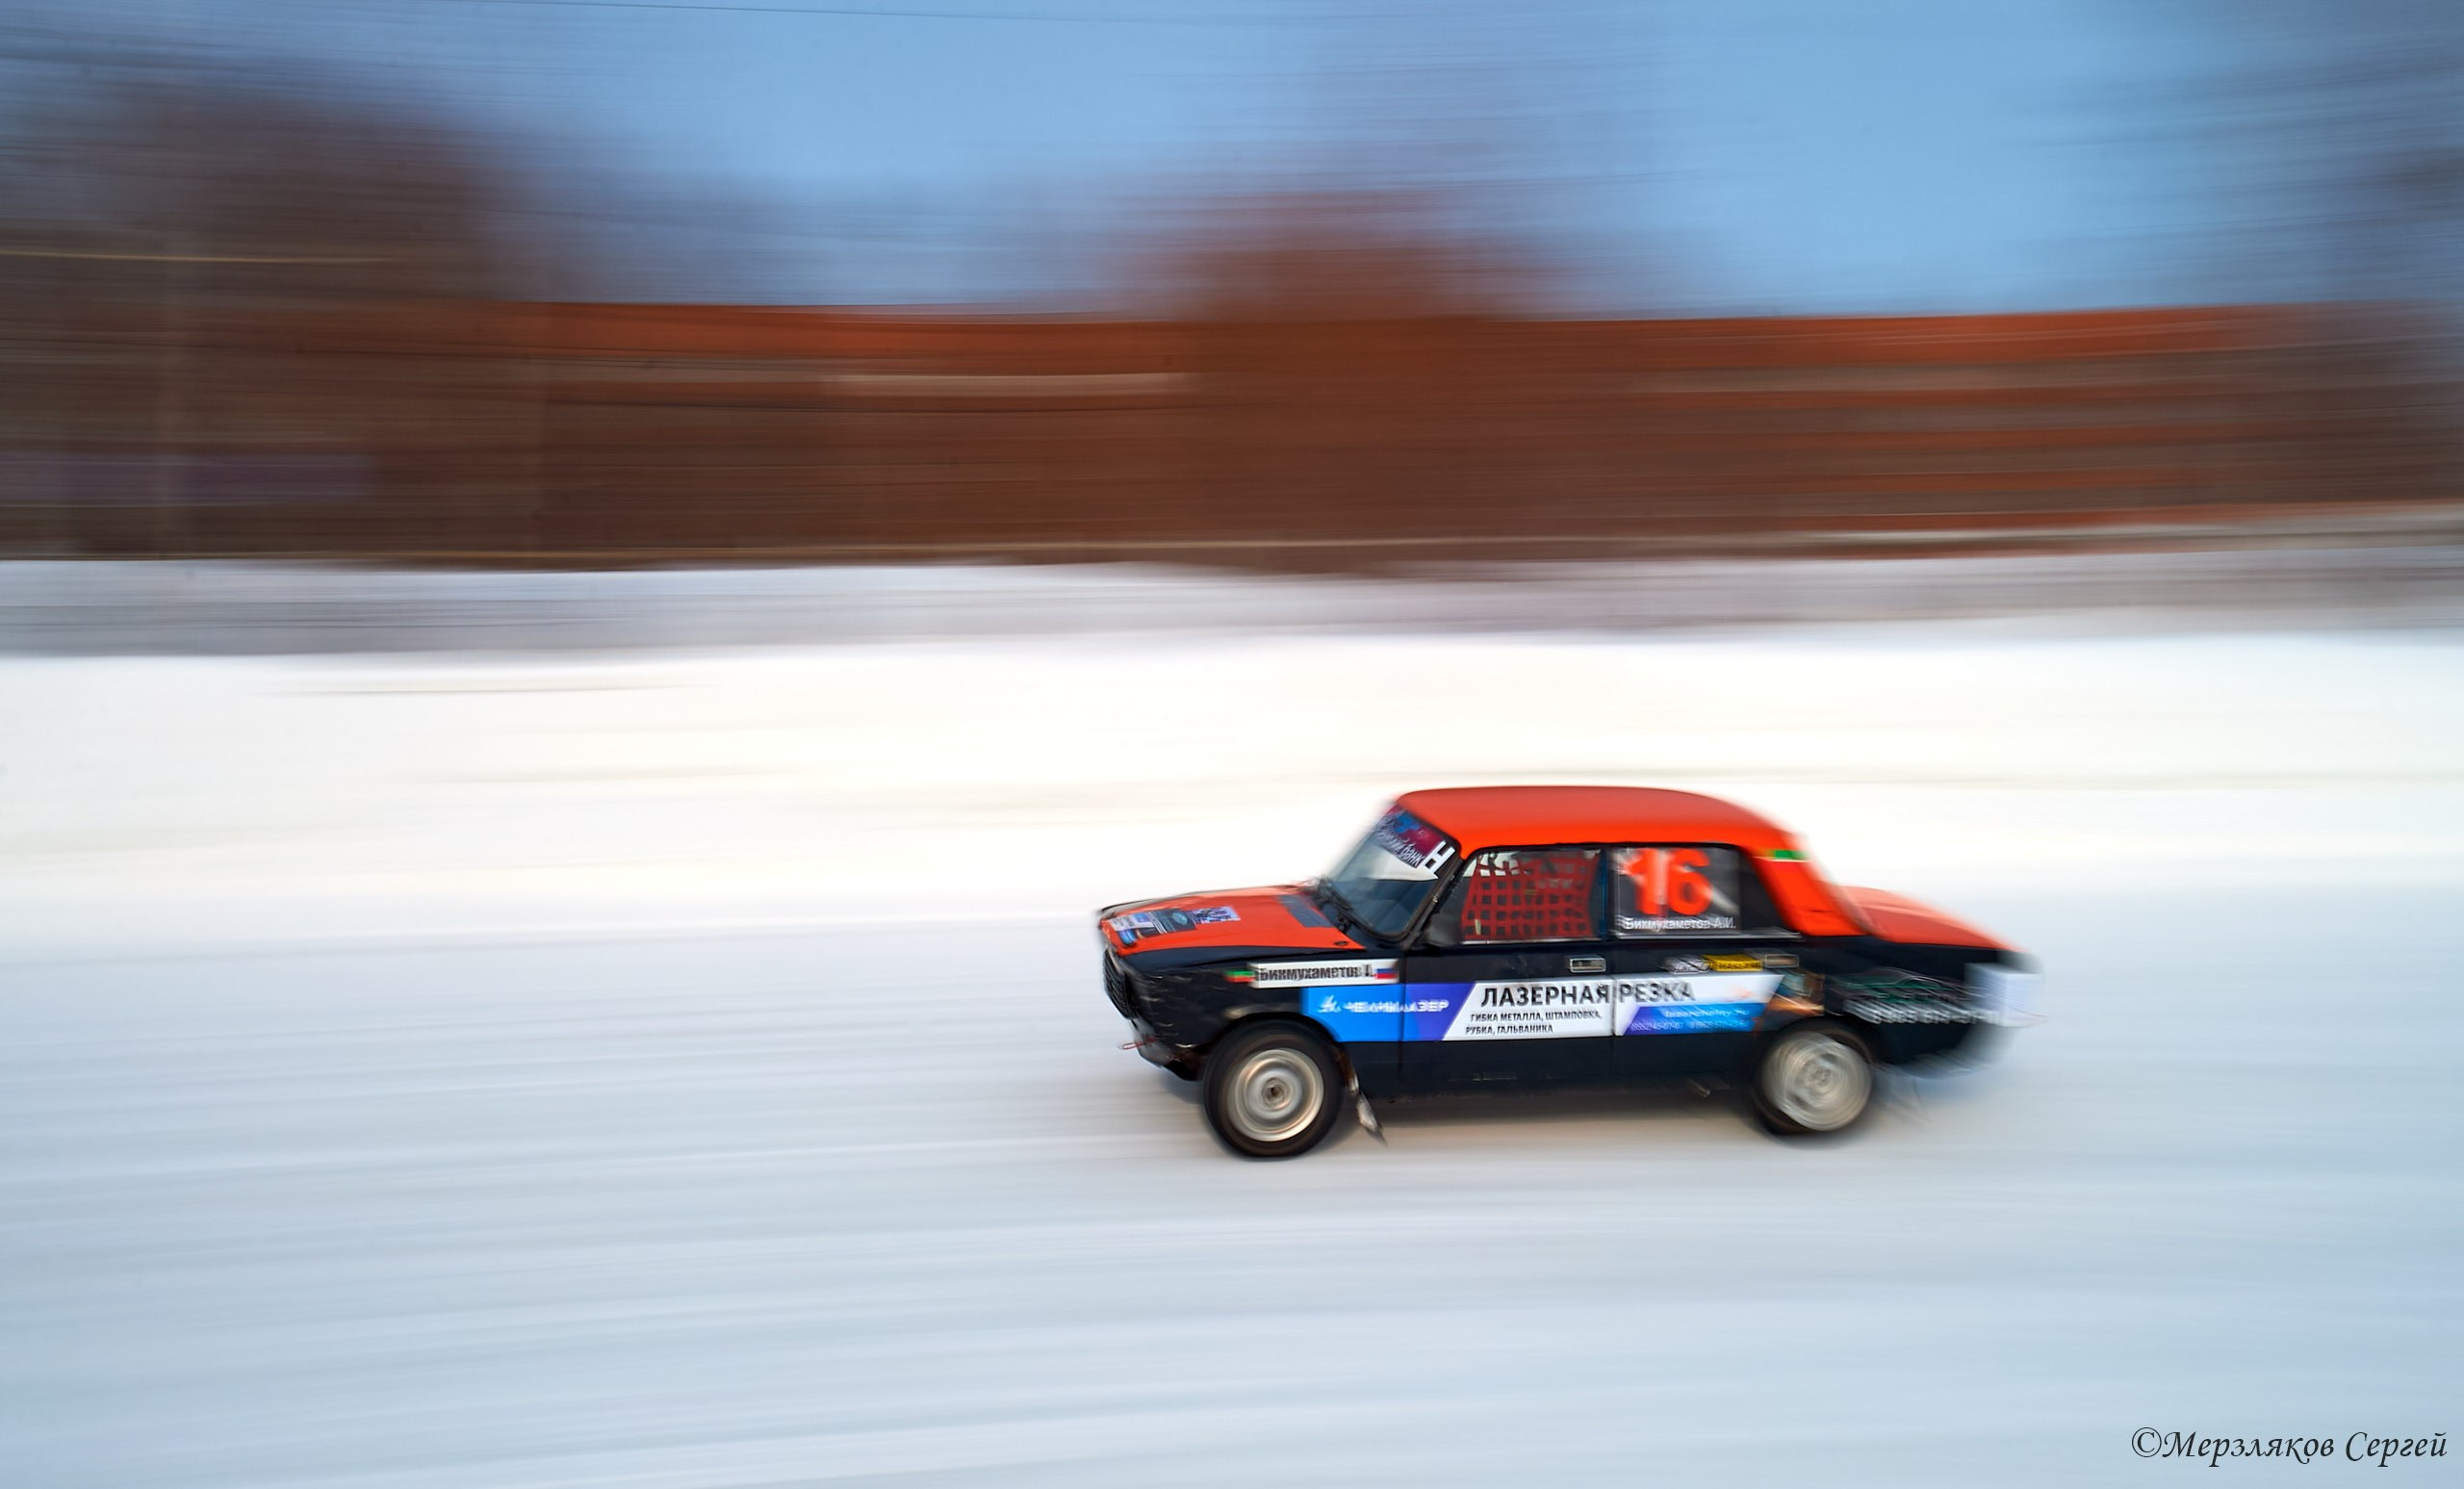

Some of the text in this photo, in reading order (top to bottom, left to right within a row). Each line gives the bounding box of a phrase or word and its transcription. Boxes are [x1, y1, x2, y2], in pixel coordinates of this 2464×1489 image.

[1629, 848, 1712, 915] 16
[1623, 917, 1711, 932] Бикмухаметов
[1258, 966, 1361, 982] Бикмухаметов
[1481, 982, 1696, 1008] ЛАЗЕРНАЯ РЕЗКА
[1471, 1011, 1603, 1022] ГИБКА МЕТАЛЛА, ШТАМПОВКА,
[1466, 1023, 1553, 1036] РУБКА, ГАЛЬВАНИКА
